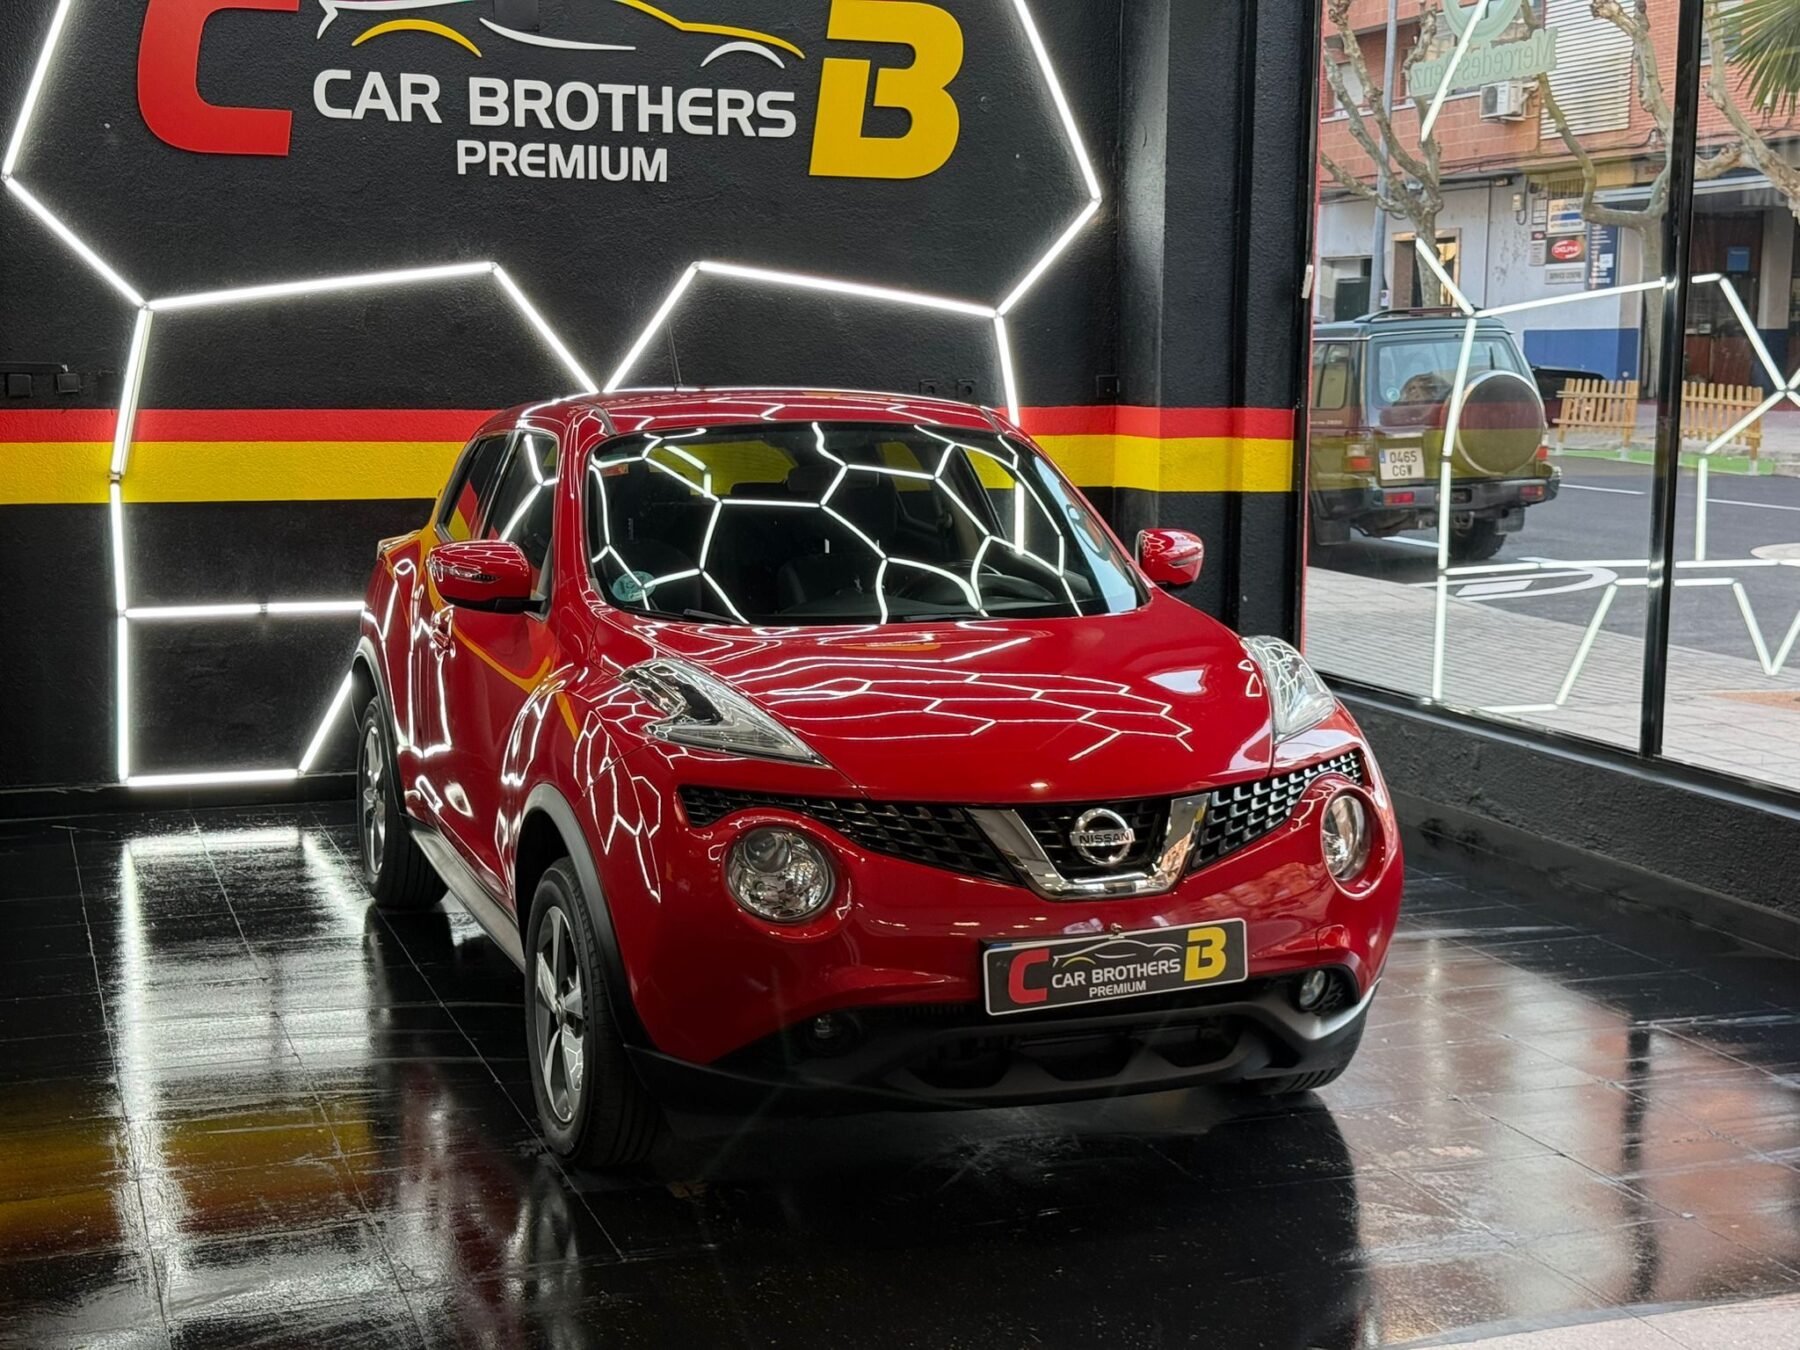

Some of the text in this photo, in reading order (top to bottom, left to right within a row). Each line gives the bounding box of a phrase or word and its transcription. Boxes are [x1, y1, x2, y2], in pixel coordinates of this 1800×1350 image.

[137, 0, 300, 156] C
[313, 68, 797, 138] CAR BROTHERS
[808, 0, 964, 179] B
[456, 138, 668, 184] PREMIUM
[1389, 450, 1418, 464] 0465
[1079, 832, 1130, 844] NISSAN
[1008, 948, 1050, 1005] C
[1051, 957, 1182, 989] CAR BROTHERS
[1184, 926, 1227, 982] B
[1088, 980, 1147, 999] PREMIUM
